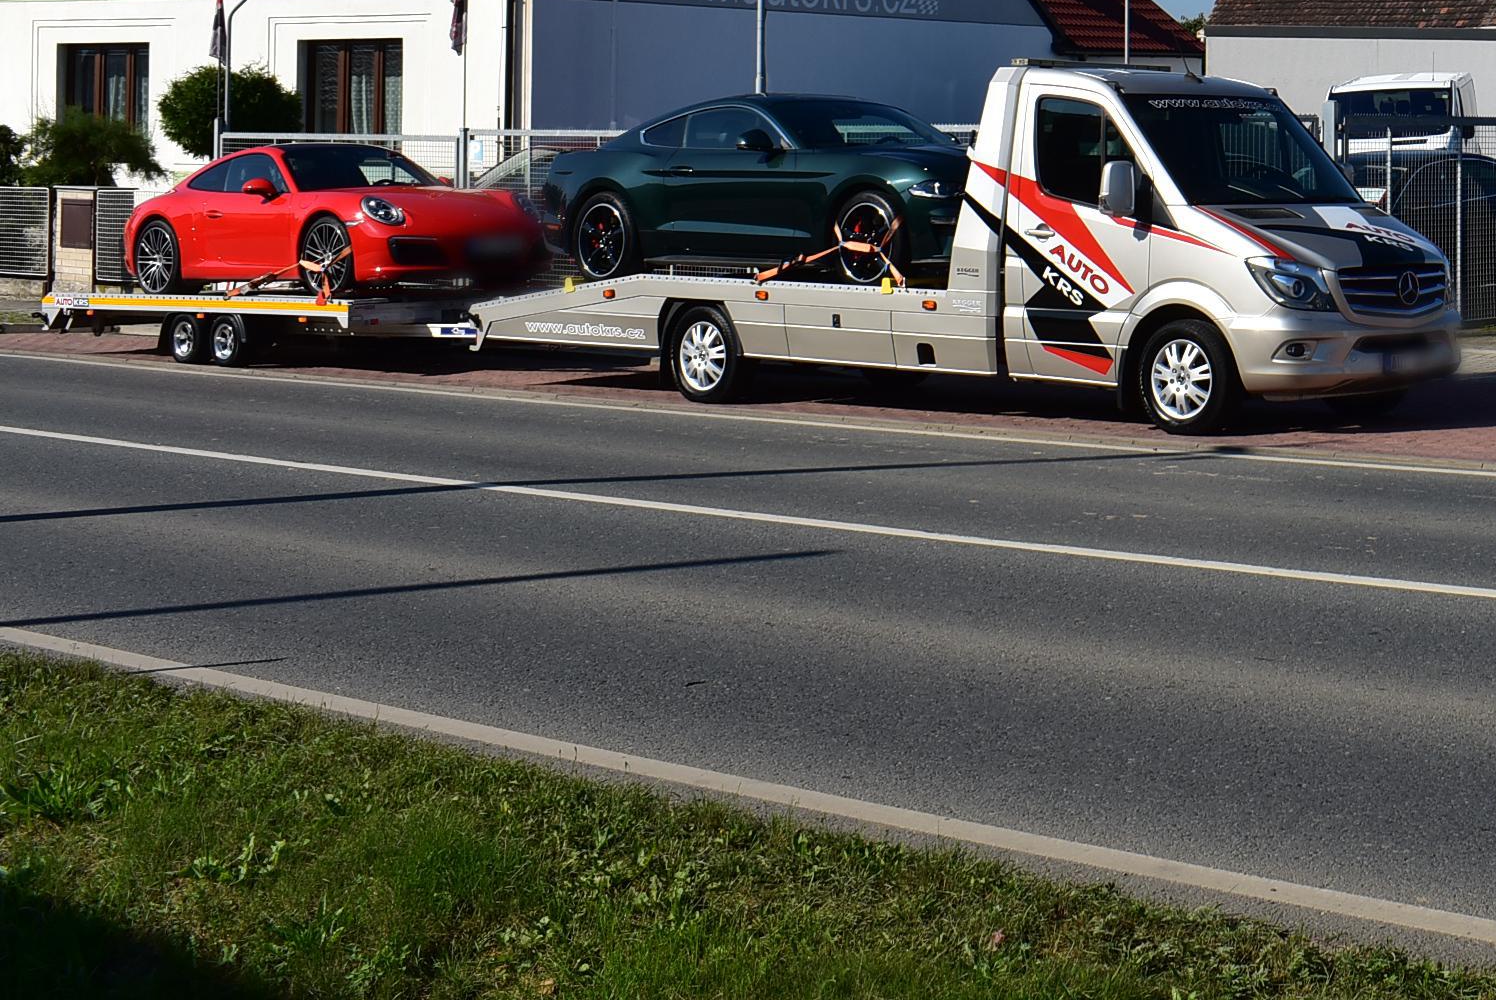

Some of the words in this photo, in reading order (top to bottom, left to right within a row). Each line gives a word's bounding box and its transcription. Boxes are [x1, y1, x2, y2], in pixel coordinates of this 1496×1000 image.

[1345, 222, 1415, 243] AUTO
[1049, 244, 1109, 294] AUTO
[1042, 265, 1084, 306] KRS
[55, 298, 73, 306] AUTO
[73, 298, 89, 306] KRS
[525, 322, 646, 340] www.autokrs.cz
